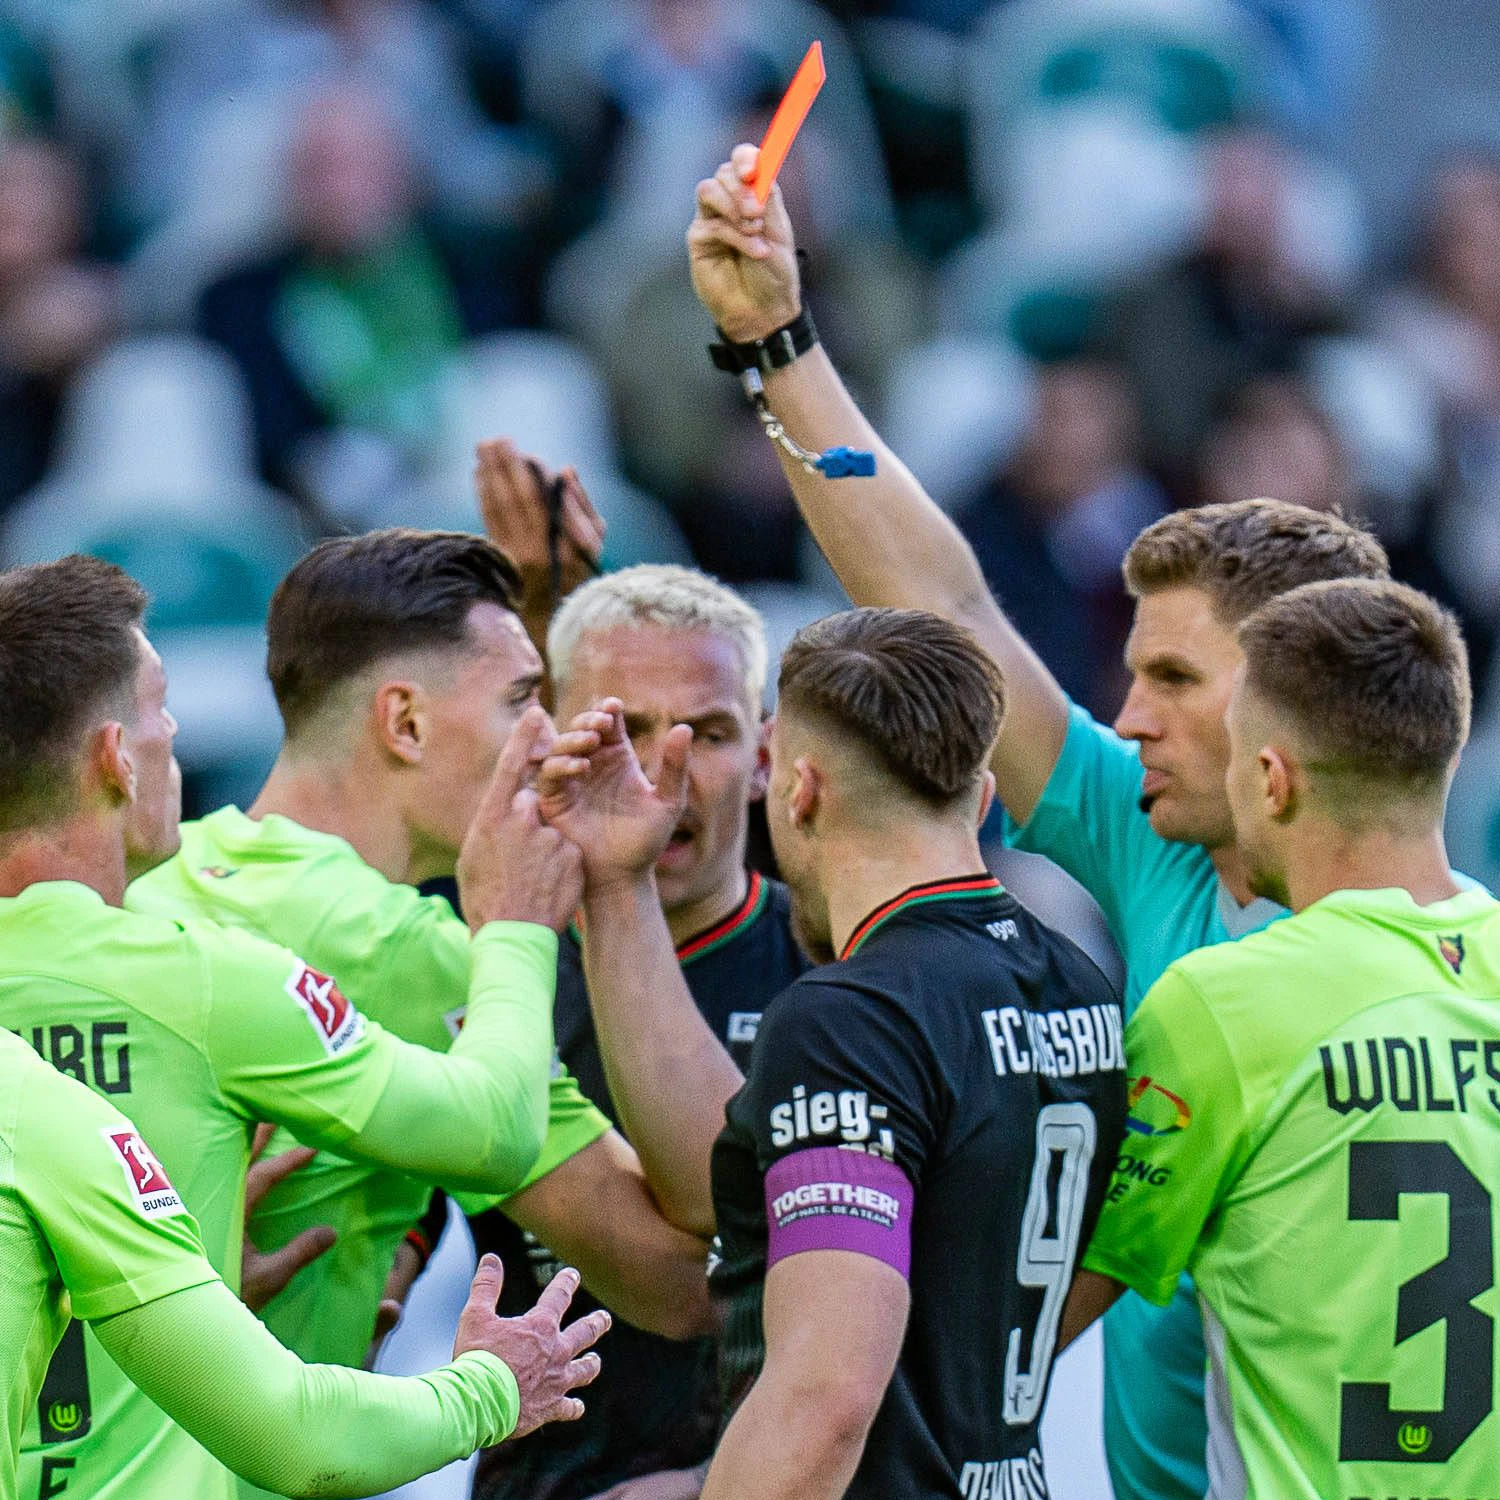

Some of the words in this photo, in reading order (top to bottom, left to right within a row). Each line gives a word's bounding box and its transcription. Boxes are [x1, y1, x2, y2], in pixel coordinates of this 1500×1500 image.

[770, 1084, 888, 1147] sieg-
[772, 1182, 900, 1221] TOGETHER!
[1005, 1101, 1097, 1425] 9
[1339, 1141, 1494, 1464] 3
